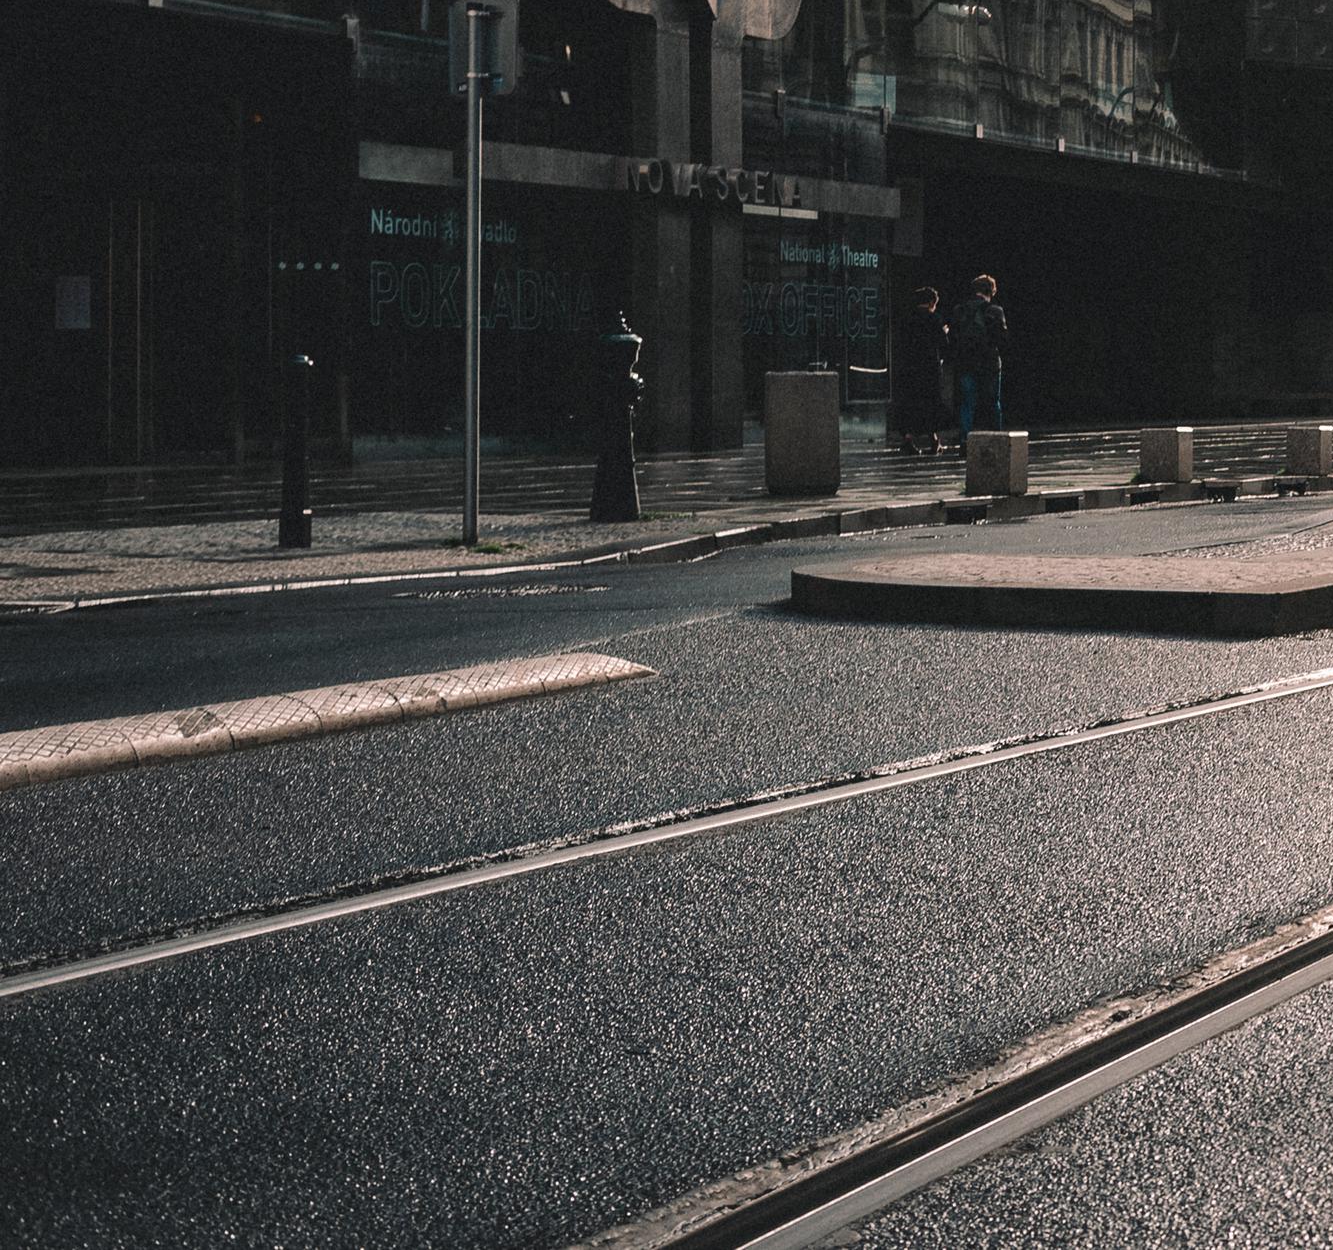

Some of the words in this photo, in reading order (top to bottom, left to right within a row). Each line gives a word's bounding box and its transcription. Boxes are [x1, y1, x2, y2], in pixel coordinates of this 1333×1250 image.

[370, 208, 438, 239] Národní
[780, 240, 825, 264] National
[841, 245, 878, 268] Theatre
